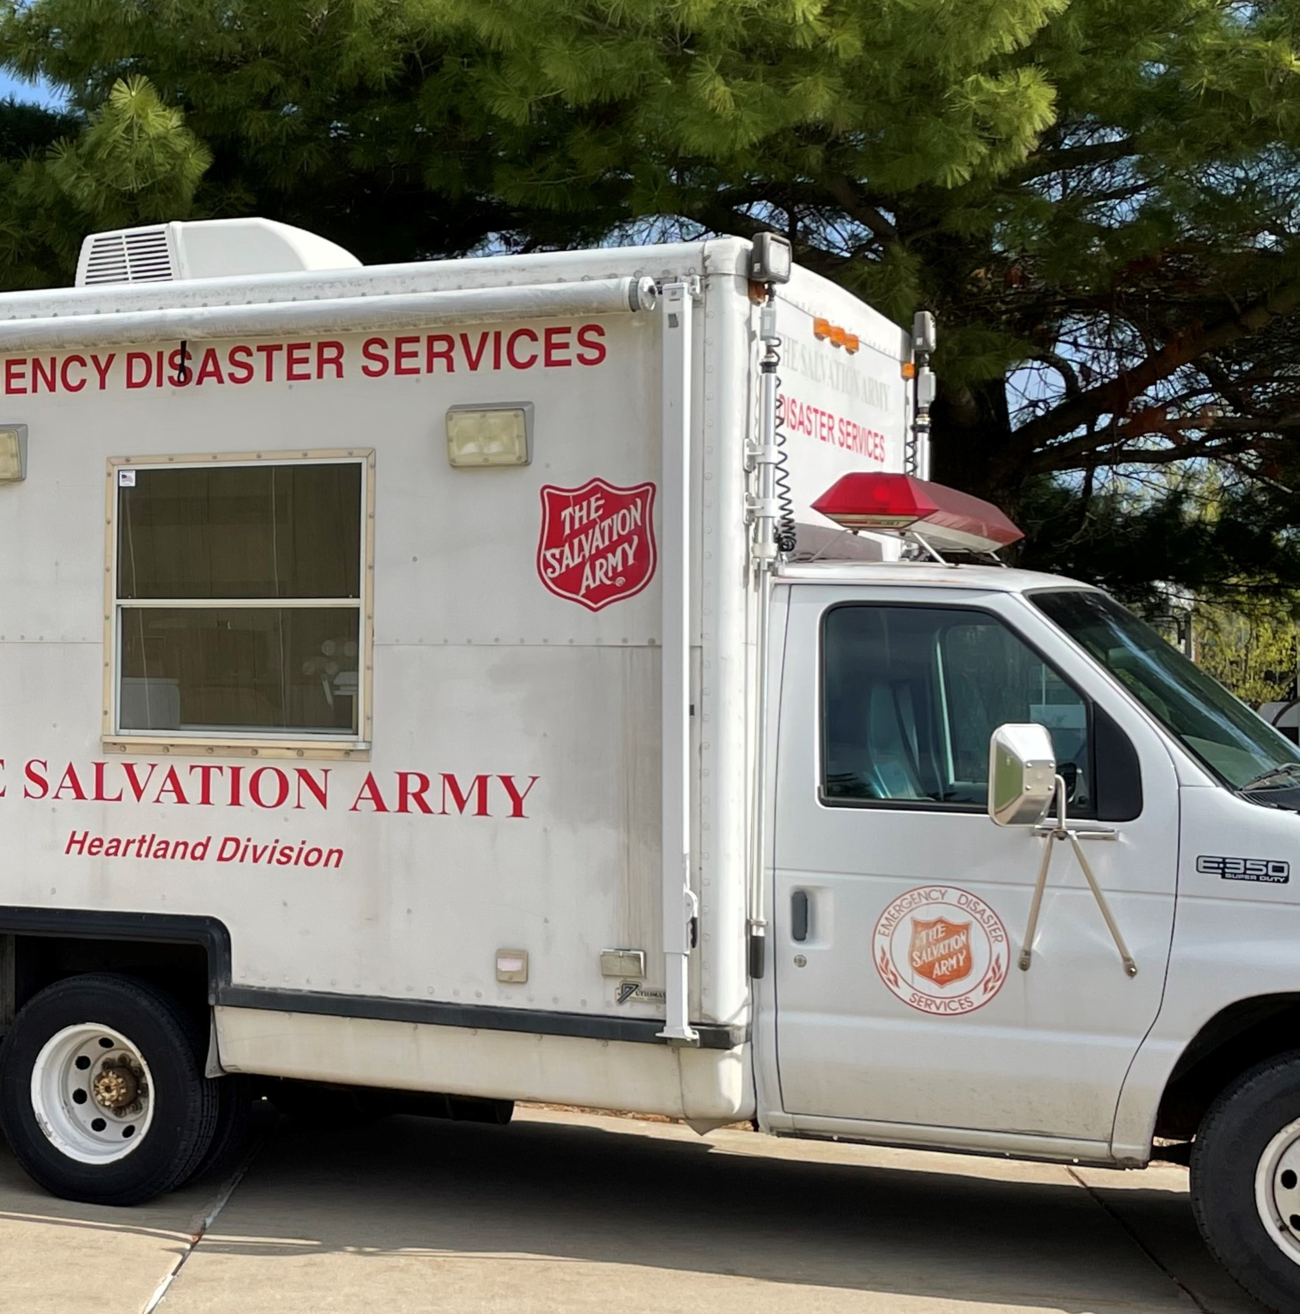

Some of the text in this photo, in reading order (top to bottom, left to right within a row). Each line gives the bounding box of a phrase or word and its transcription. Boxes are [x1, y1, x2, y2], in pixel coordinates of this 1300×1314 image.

[125, 339, 345, 389] DISASTER
[360, 323, 607, 379] SERVICES
[779, 393, 886, 464] DISASTER SERVICES
[544, 497, 642, 579] SALVATION
[561, 494, 605, 539] THE
[579, 535, 639, 597] ARMY
[23, 758, 332, 811] SALVATION
[348, 770, 541, 819] ARMY
[64, 829, 345, 869] Heartland Division
[877, 889, 1004, 944] EMERGENCY DISASTER
[918, 922, 947, 945] THE
[911, 929, 968, 968] SALVATION
[931, 949, 967, 979] ARMY
[908, 992, 974, 1012] SERVICES
